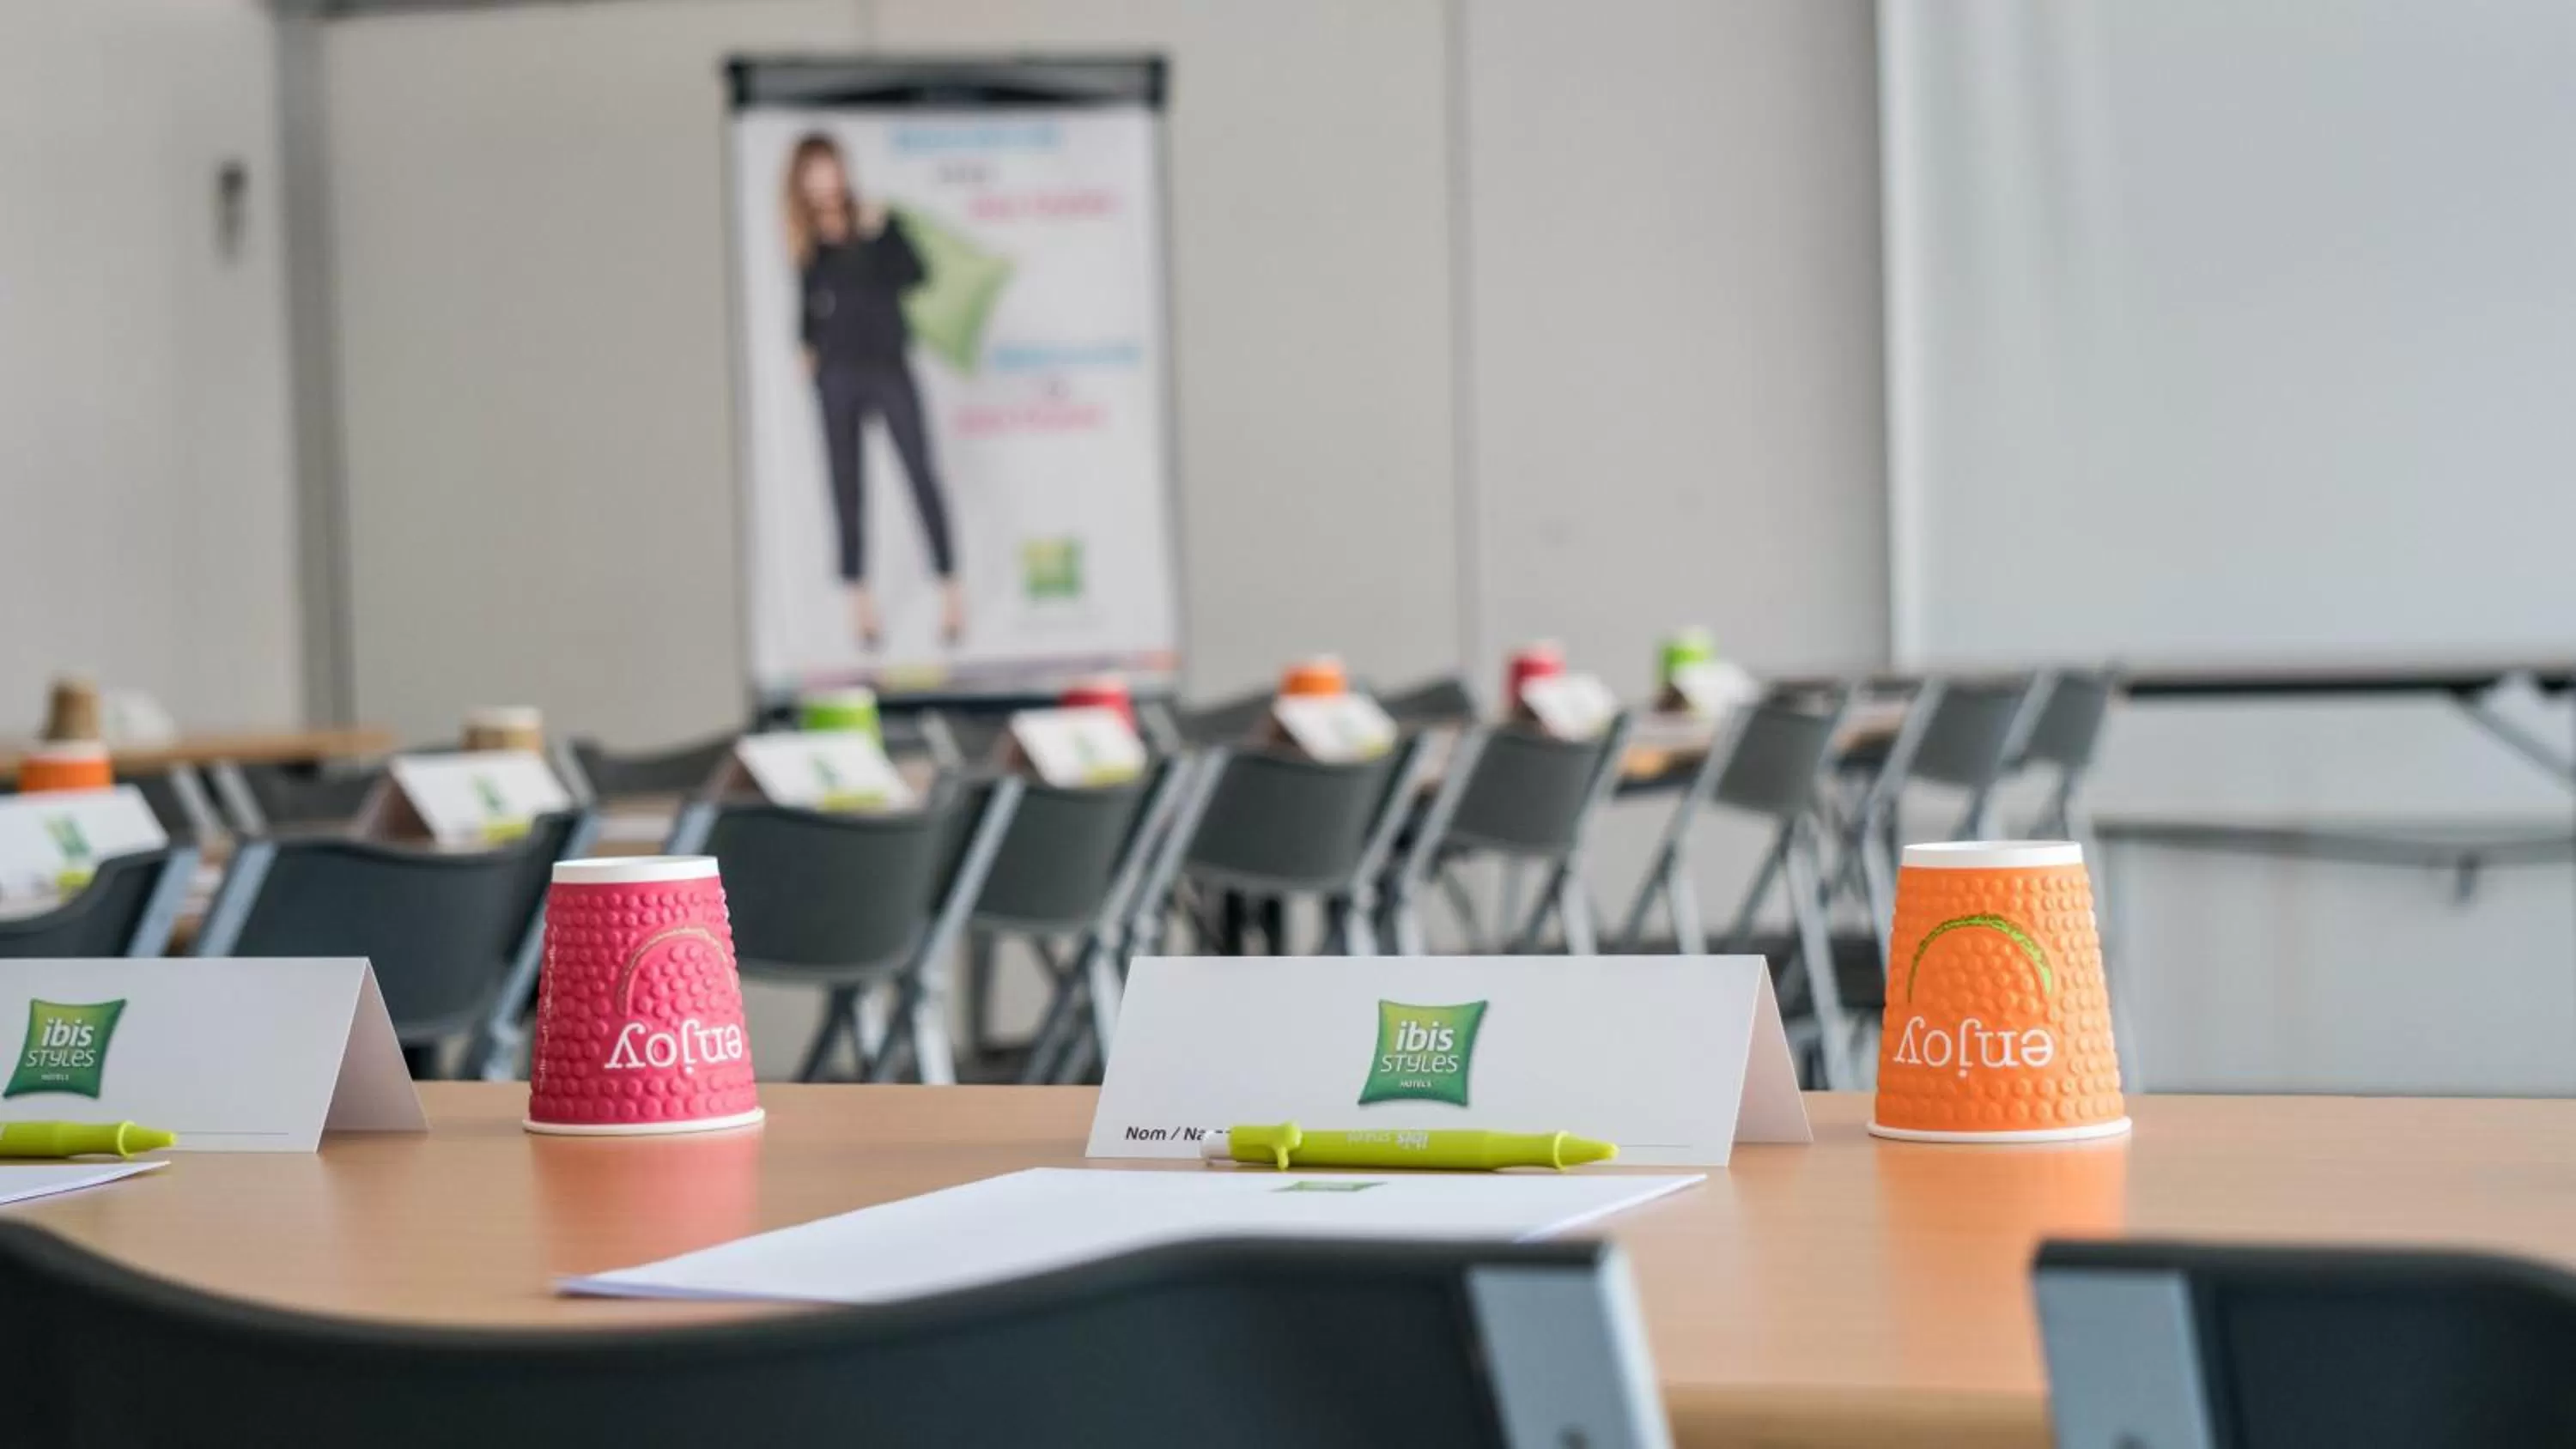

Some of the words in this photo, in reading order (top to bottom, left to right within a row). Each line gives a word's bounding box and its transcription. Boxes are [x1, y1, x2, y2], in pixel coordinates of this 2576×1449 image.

[41, 1018, 94, 1046] ibis
[604, 1019, 743, 1074] enjoy
[1396, 1020, 1454, 1052] ibis
[1893, 1016, 2055, 1078] enjoy
[1126, 1126, 1166, 1140] Nom
[1170, 1126, 1181, 1140] /
